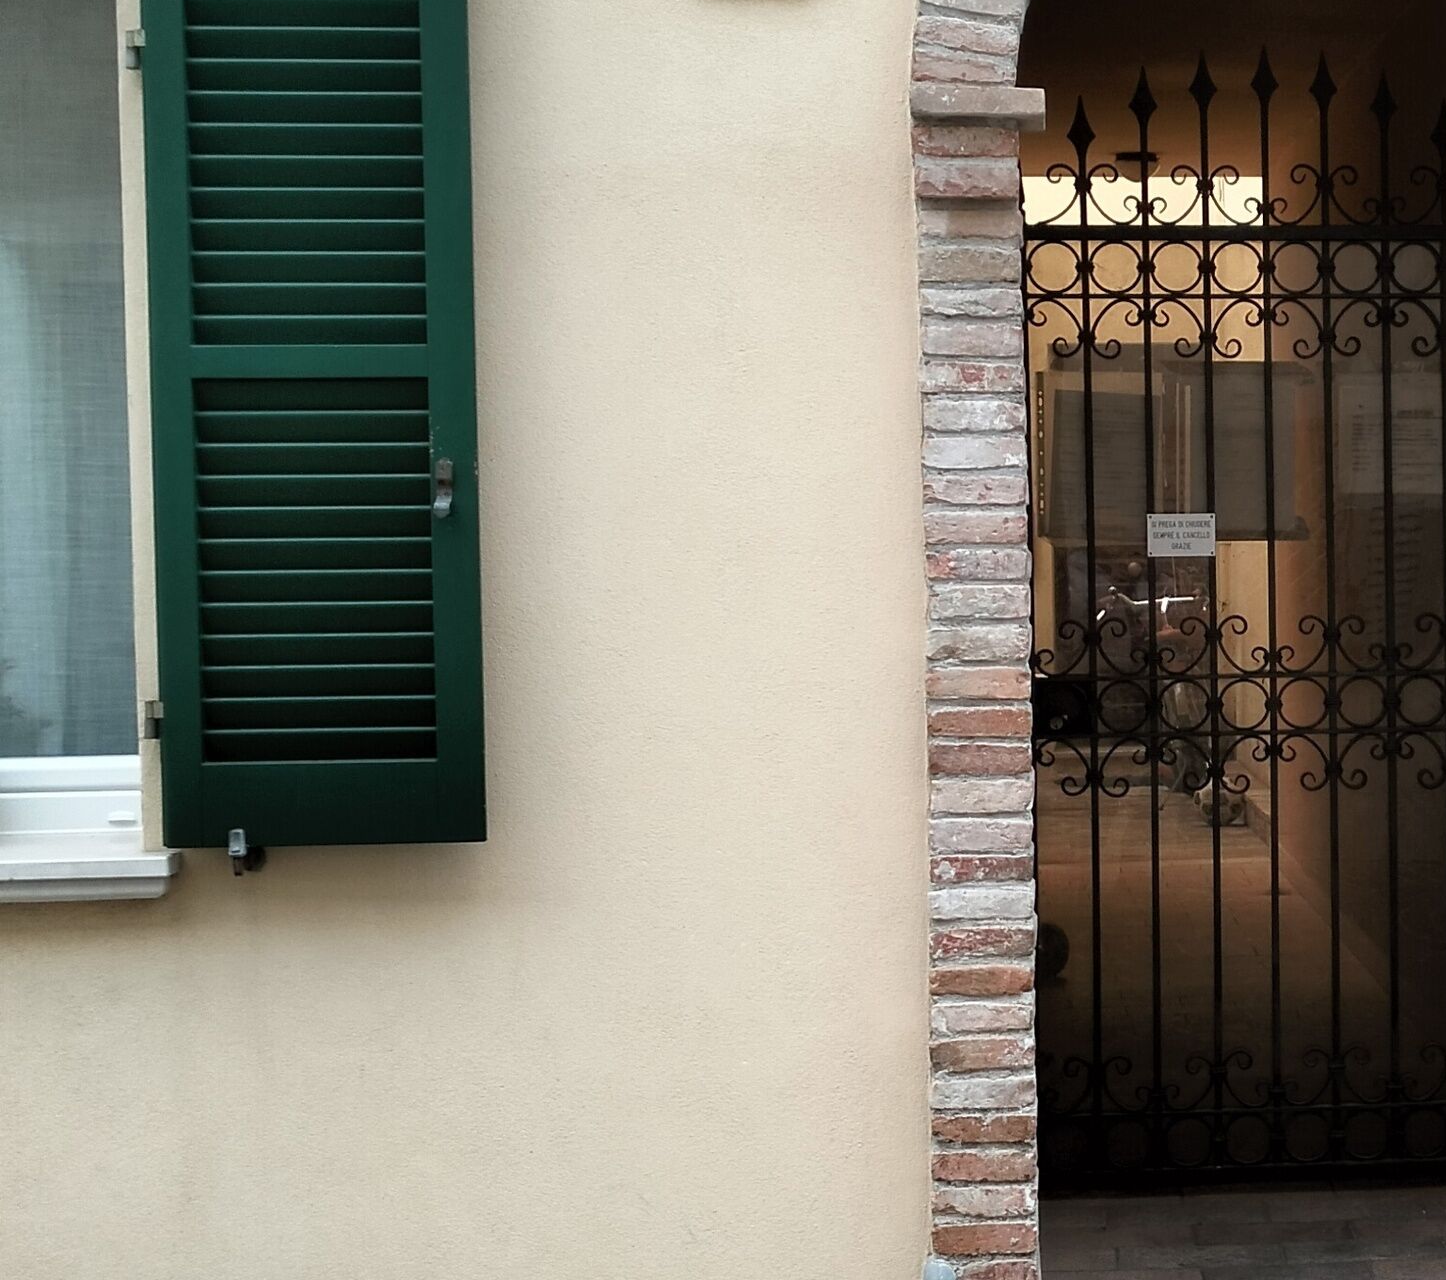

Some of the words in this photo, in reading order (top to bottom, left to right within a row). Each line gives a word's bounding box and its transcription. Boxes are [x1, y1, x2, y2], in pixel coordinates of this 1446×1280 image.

[1158, 520, 1176, 528] PREGA
[1185, 520, 1211, 528] CHIUDERE
[1153, 531, 1174, 539] SEMPRE
[1182, 531, 1210, 539] CANCELLO
[1171, 542, 1192, 550] GRAZIE
